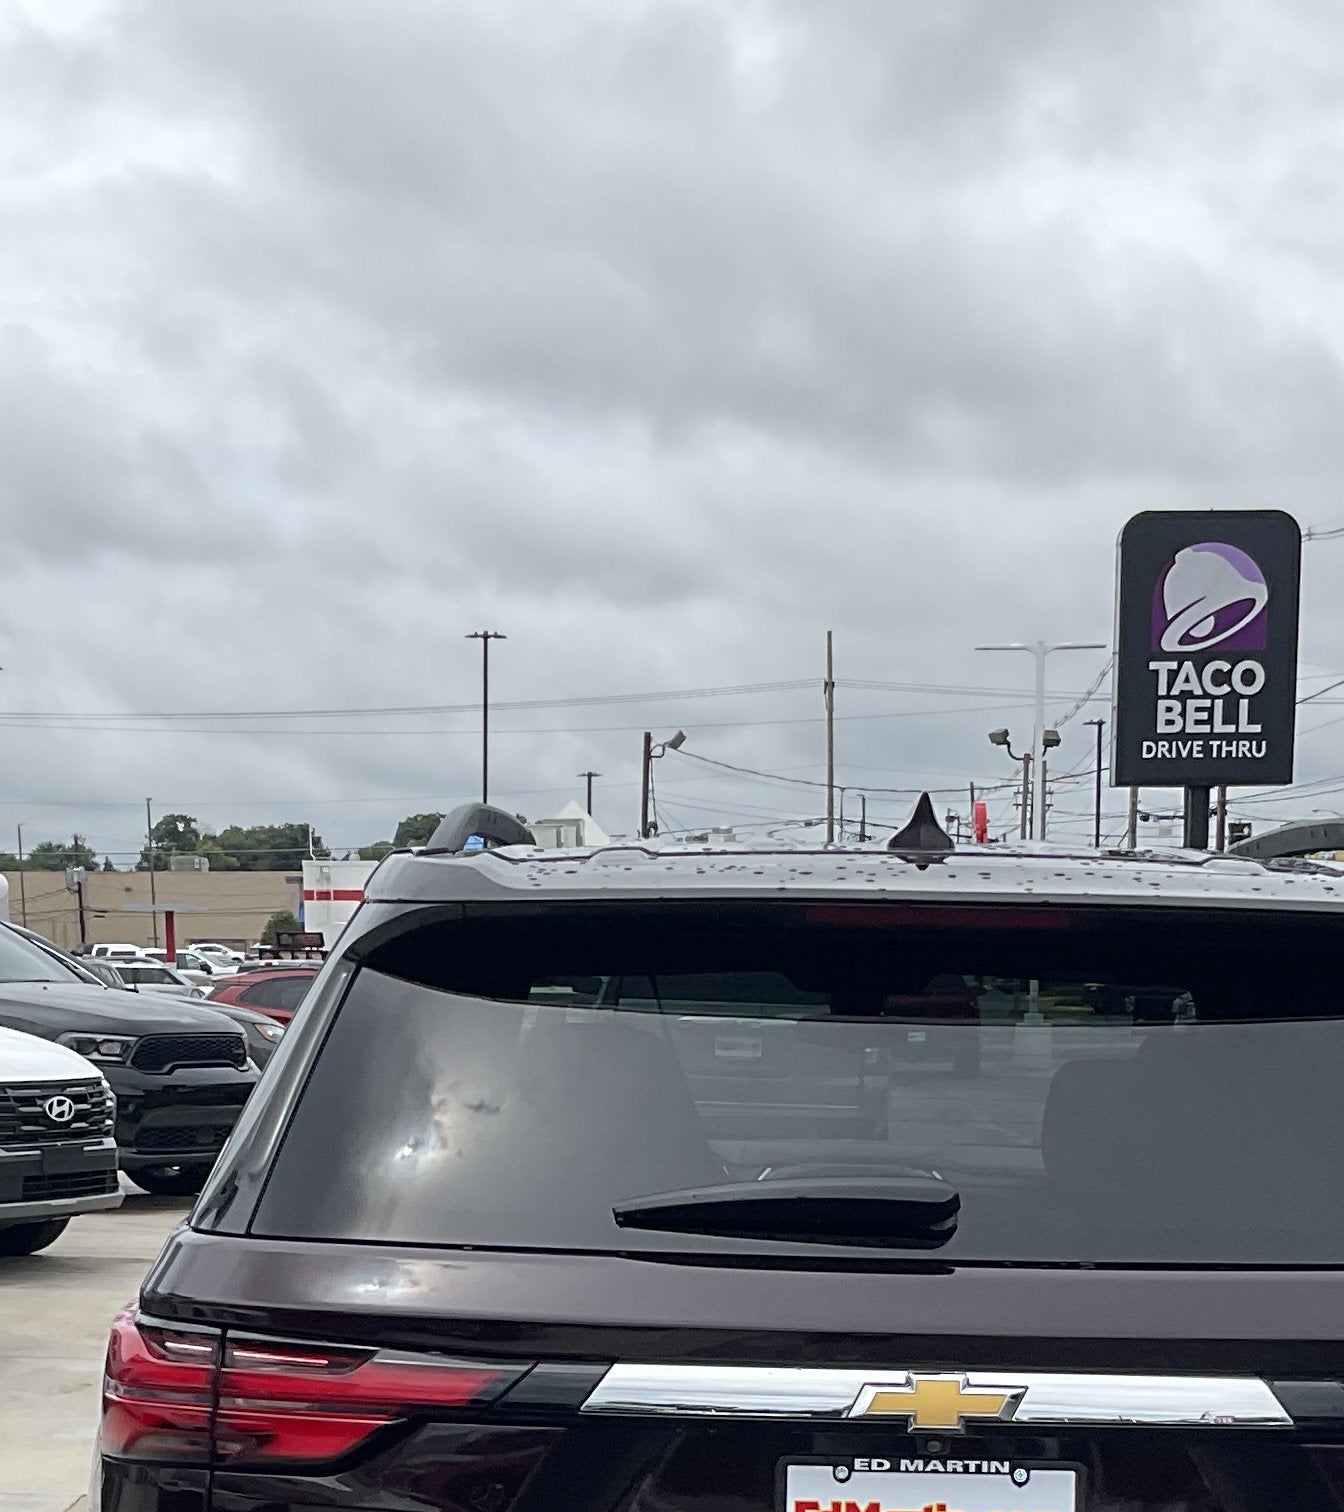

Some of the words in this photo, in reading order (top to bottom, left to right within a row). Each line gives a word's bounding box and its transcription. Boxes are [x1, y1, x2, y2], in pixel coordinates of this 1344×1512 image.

[1148, 660, 1266, 696] TACO
[1156, 699, 1262, 734] BELL
[1141, 740, 1204, 759] DRIVE
[1208, 739, 1267, 759] THRU
[853, 1458, 891, 1472] ED
[899, 1459, 1011, 1474] MARTIN
